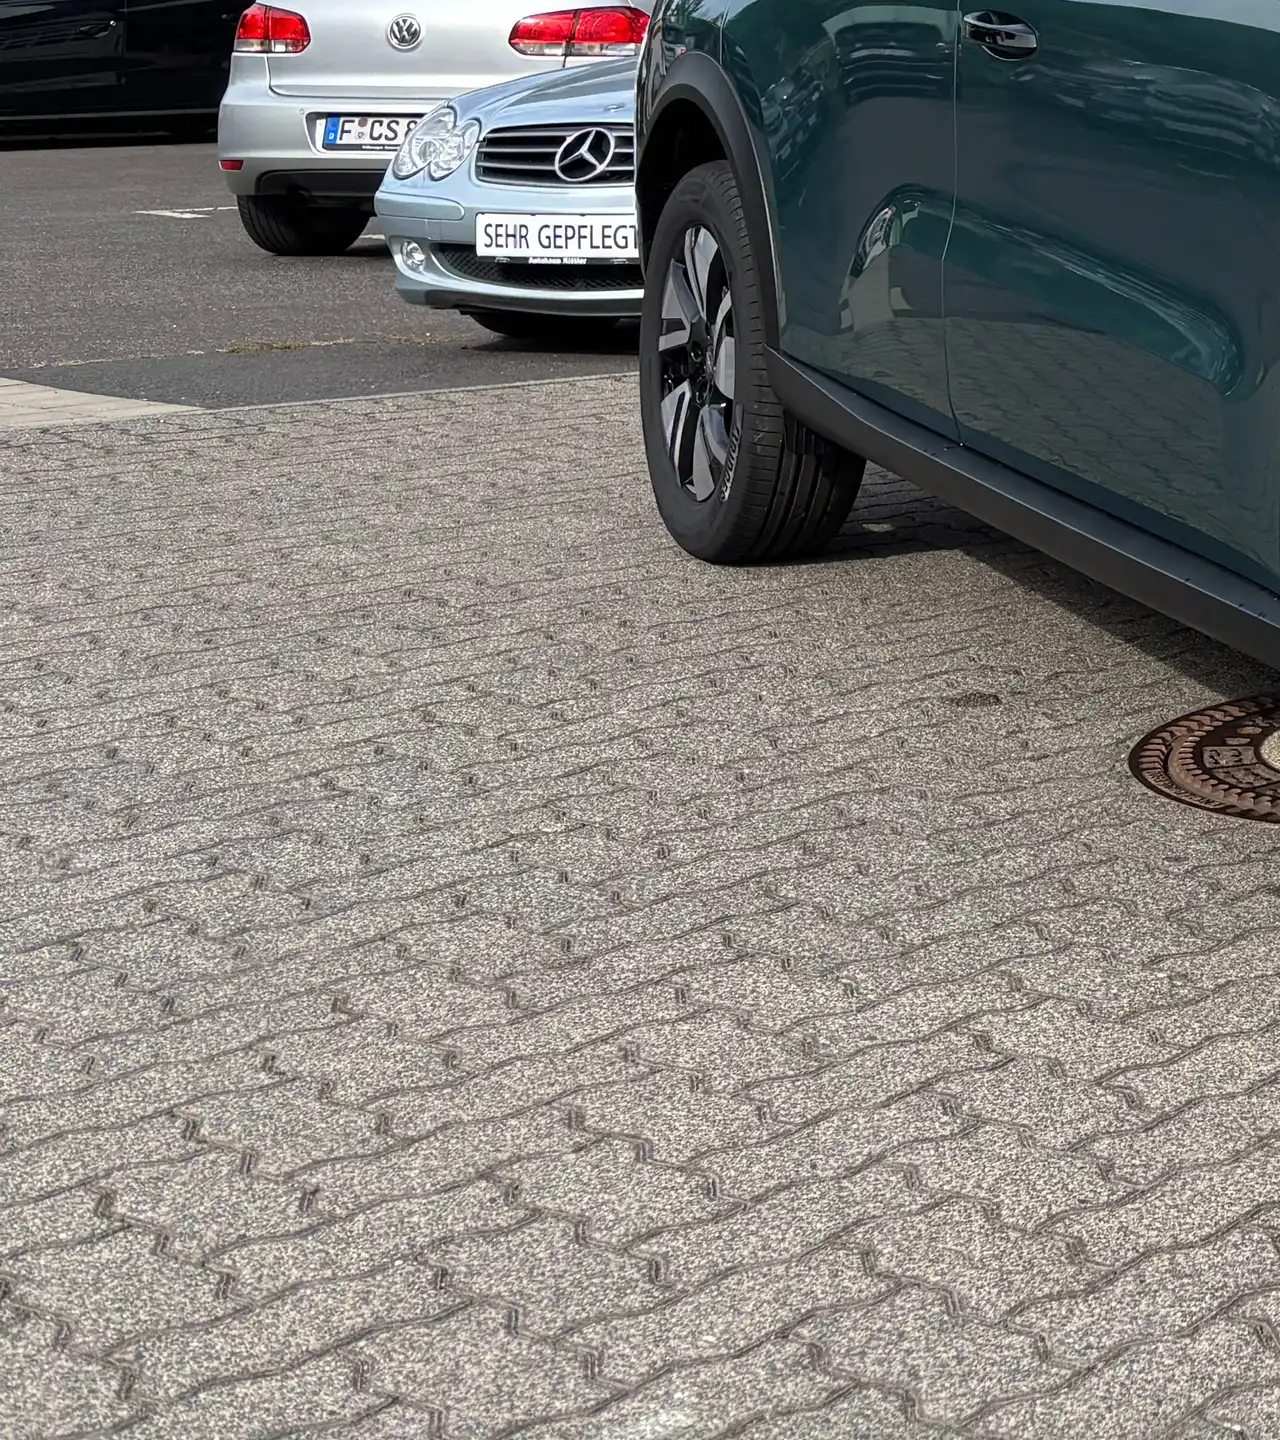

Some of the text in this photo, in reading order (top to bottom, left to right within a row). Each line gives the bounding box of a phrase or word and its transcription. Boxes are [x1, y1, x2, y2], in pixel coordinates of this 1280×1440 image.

[339, 119, 356, 141] F
[369, 119, 400, 142] CS
[484, 223, 530, 249] SEHR
